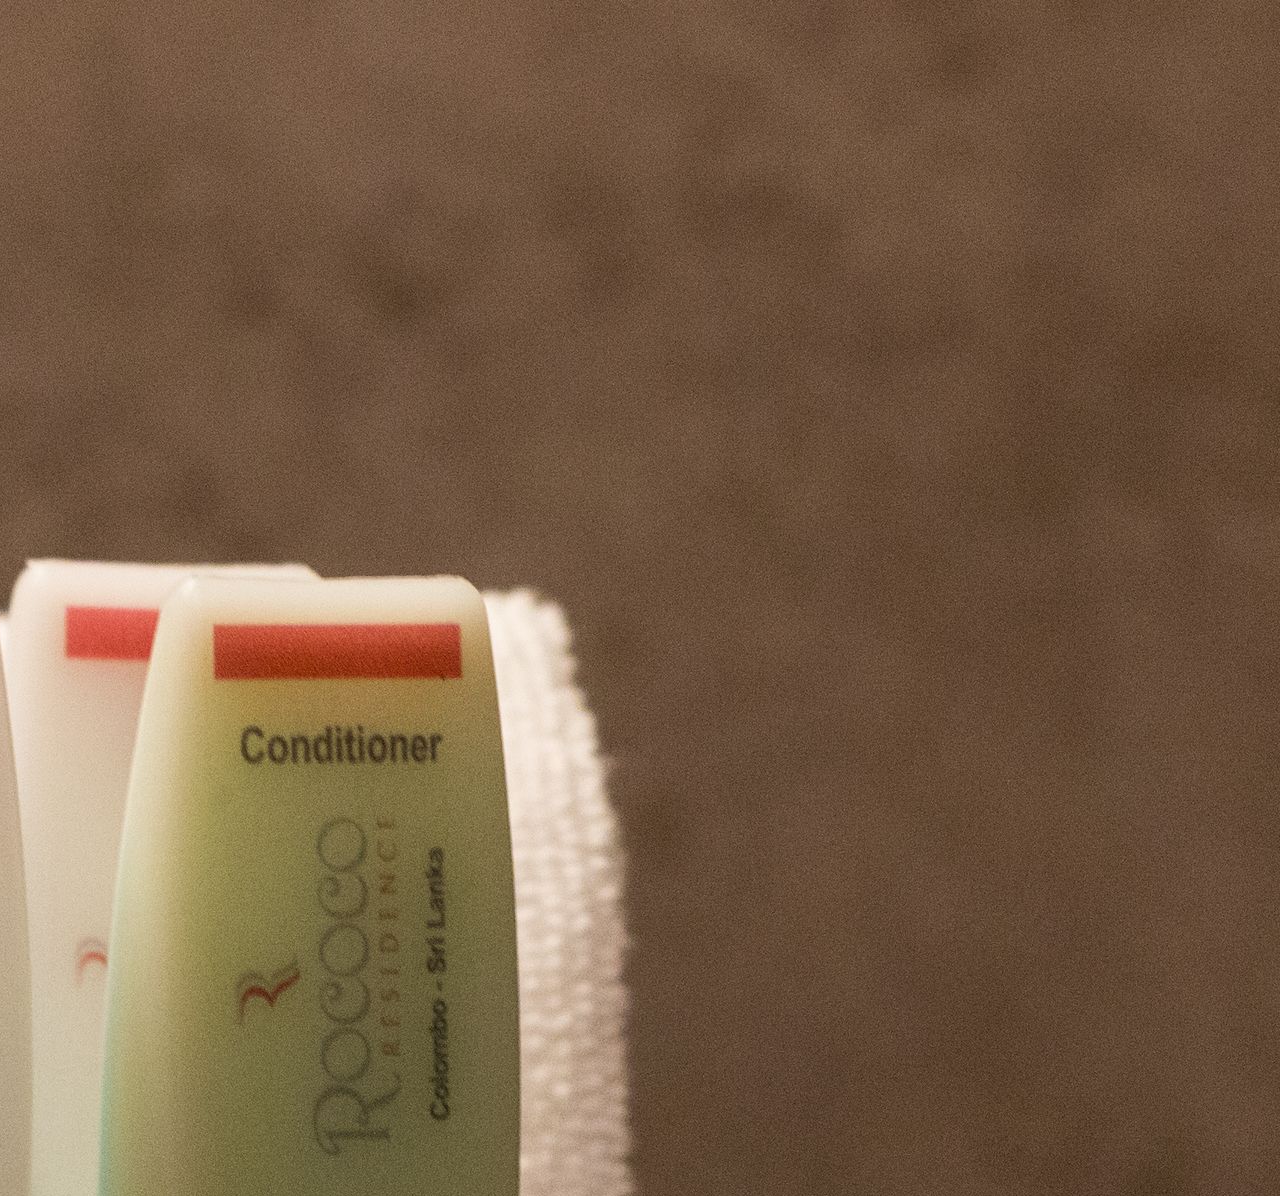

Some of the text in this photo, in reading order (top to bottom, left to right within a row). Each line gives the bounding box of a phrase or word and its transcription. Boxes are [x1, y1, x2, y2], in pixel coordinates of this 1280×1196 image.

[238, 724, 444, 767] Conditioner
[422, 846, 447, 931] Lanka
[375, 815, 402, 1058] RESIDENCE
[424, 936, 448, 975] Sri
[426, 998, 452, 1123] Colombo
